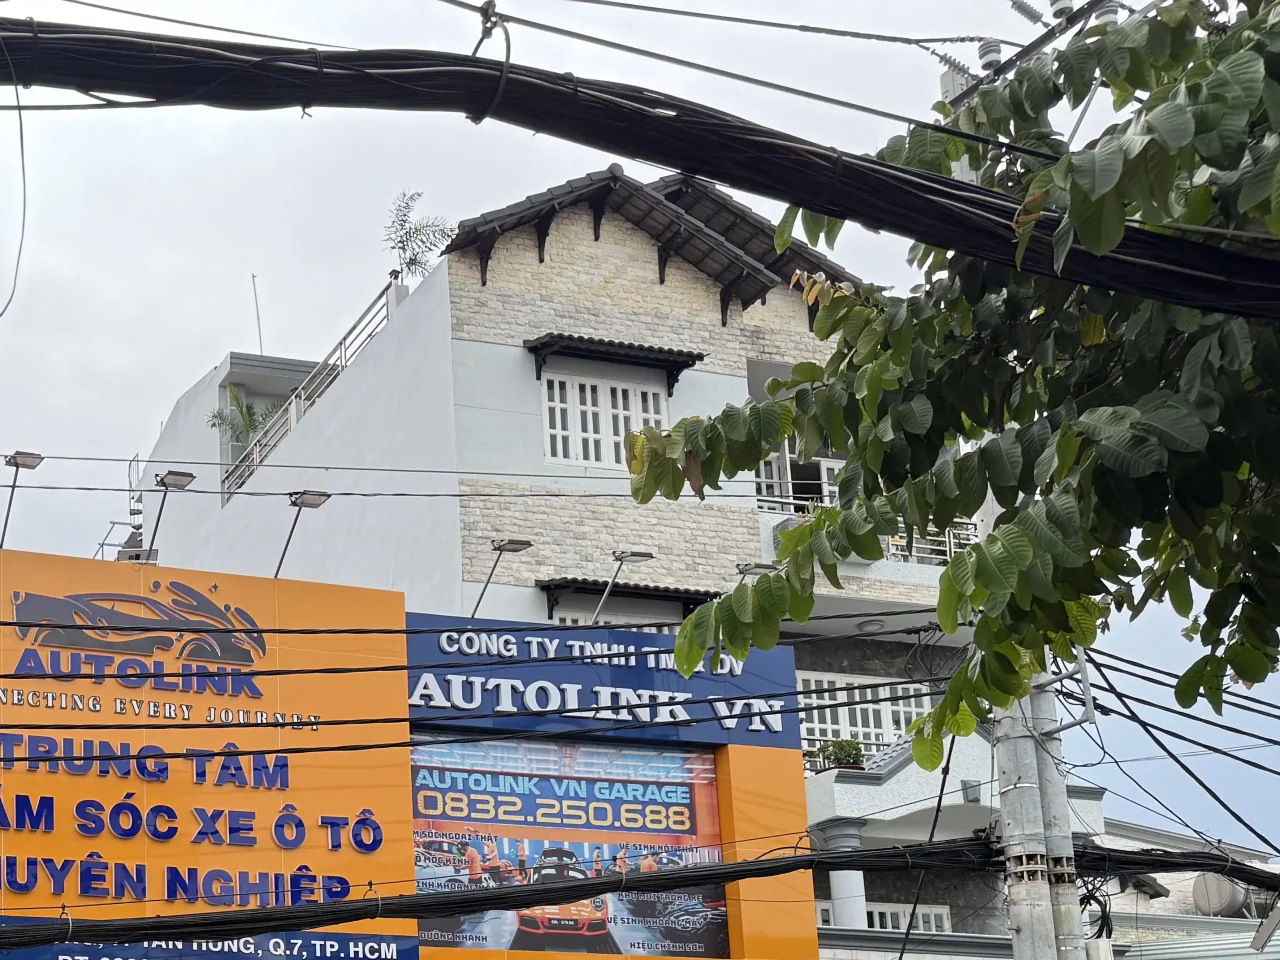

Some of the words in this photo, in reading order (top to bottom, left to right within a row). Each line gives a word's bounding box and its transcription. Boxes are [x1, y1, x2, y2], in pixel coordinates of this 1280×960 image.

[524, 636, 560, 660] TY
[566, 640, 636, 667] TNHH
[12, 647, 265, 699] AUTOLINK
[114, 698, 193, 721] EVERY
[206, 706, 321, 731] JOURNEY
[408, 672, 697, 726] AUTOLINK
[707, 695, 785, 733] VN
[185, 742, 290, 791] TÂM
[415, 769, 541, 796] AUTOLINK
[550, 779, 587, 798] VN
[593, 781, 691, 804] GARAGE
[74, 792, 179, 842] SÓC
[191, 806, 258, 847] XE
[271, 803, 308, 850] Ô
[318, 808, 384, 853] TÔ
[416, 789, 691, 832] 0832.250.688
[632, 843, 656, 852] SINH
[415, 880, 436, 890] INH
[454, 932, 488, 943] NHANH
[620, 917, 644, 926] SINH
[268, 938, 307, 959] Q.7,
[311, 940, 345, 958] TP.
[349, 942, 398, 960] HCM
[629, 940, 653, 952] HIỆU
